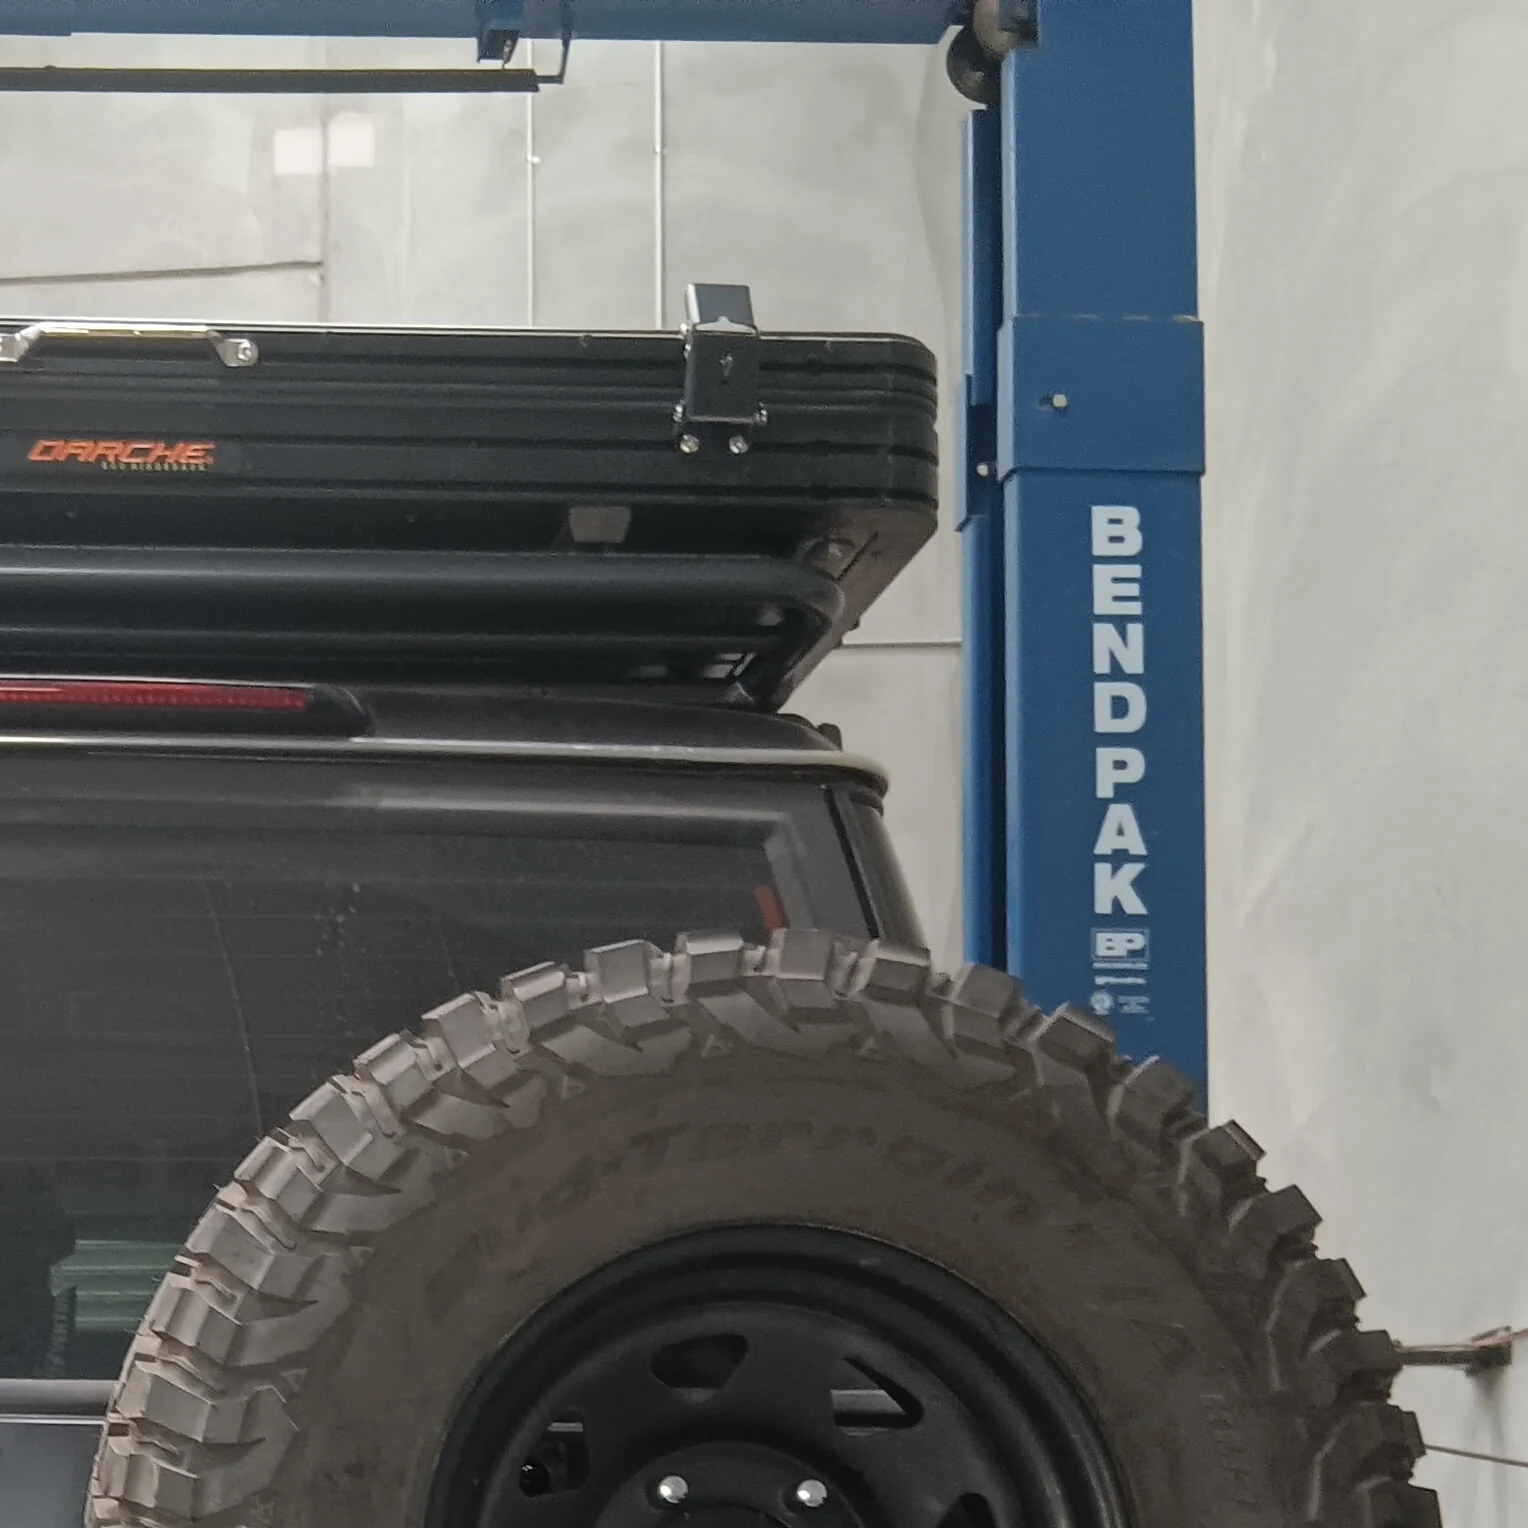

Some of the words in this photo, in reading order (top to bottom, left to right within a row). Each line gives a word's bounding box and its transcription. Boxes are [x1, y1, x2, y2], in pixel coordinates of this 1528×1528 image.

[26, 438, 216, 465] DARCHE
[1090, 504, 1149, 915] BENDPAK
[1096, 932, 1145, 957] BP
